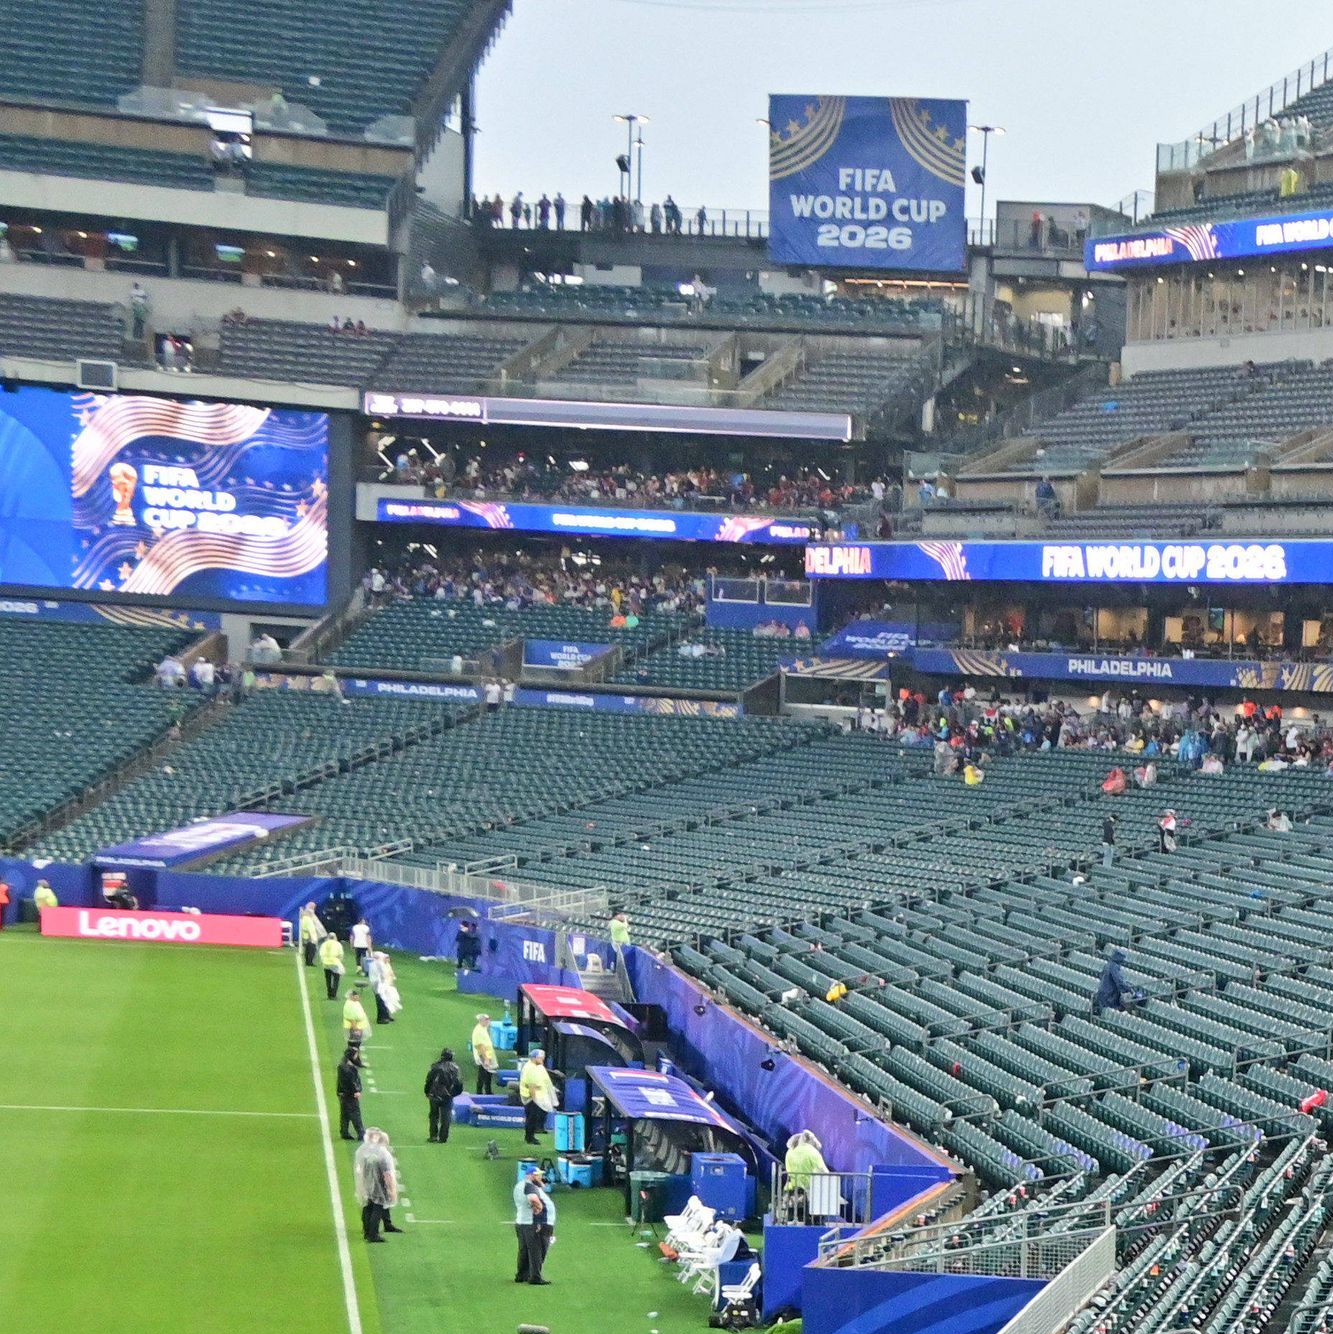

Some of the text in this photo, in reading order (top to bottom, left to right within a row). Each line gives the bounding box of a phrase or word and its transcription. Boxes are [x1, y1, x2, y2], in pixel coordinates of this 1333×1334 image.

[838, 168, 897, 193] FIFA
[790, 194, 947, 223] WORLD CUP
[817, 224, 913, 249] 2026
[1255, 224, 1284, 246] FIFA
[1284, 217, 1329, 243] WORLD
[143, 464, 200, 489] FIFA
[142, 485, 237, 512] WORLD
[143, 507, 197, 530] CUP
[1042, 545, 1287, 580] FIFA WORLD CUP 2026
[0, 600, 39, 613] 026
[1068, 659, 1173, 678] PHILADELPHIA
[377, 683, 478, 699] PHILADELPHIA
[79, 911, 201, 940] Lenovo
[523, 940, 545, 963] FIFA
